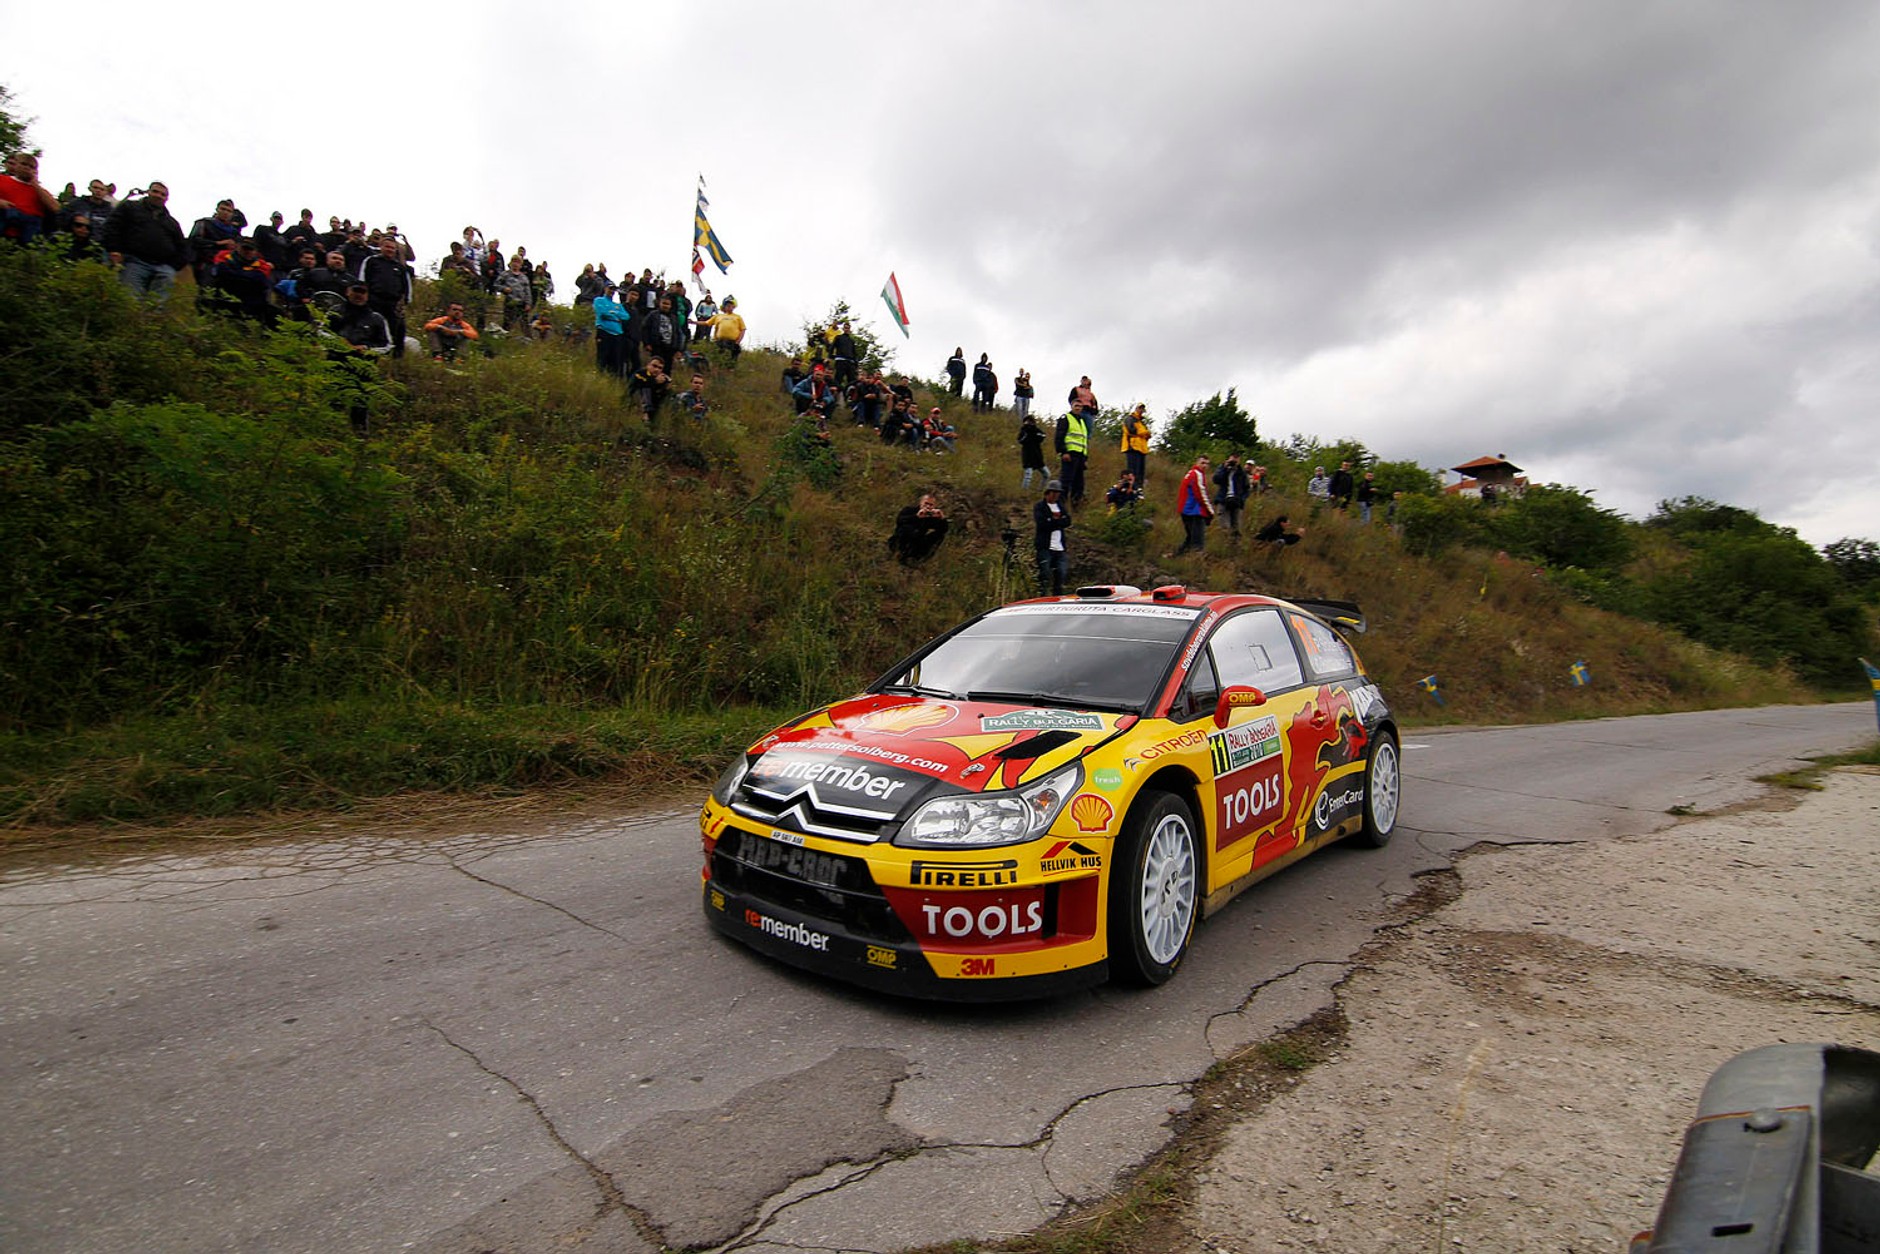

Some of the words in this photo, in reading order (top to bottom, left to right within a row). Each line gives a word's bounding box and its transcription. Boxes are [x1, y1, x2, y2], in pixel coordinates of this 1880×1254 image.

[1113, 606, 1190, 617] CARGLASS
[1289, 614, 1319, 656] 11
[1229, 693, 1256, 703] OMP
[989, 718, 1027, 727] RALLY
[1033, 716, 1098, 726] BULGARIA
[776, 741, 949, 773] www.pettersolberg.com
[1210, 734, 1229, 775] 11
[752, 761, 905, 800] remember
[1094, 775, 1121, 784] fresh
[1223, 773, 1280, 829] TOOLS
[1328, 786, 1364, 813] EnterCard
[910, 859, 1018, 887] PIRELLI
[1041, 858, 1077, 872] HELLVIK
[1081, 856, 1102, 867] HUS
[745, 909, 830, 951] remember
[922, 901, 1043, 937] TOOLS
[867, 948, 897, 966] OMP
[961, 958, 995, 976] 3M
